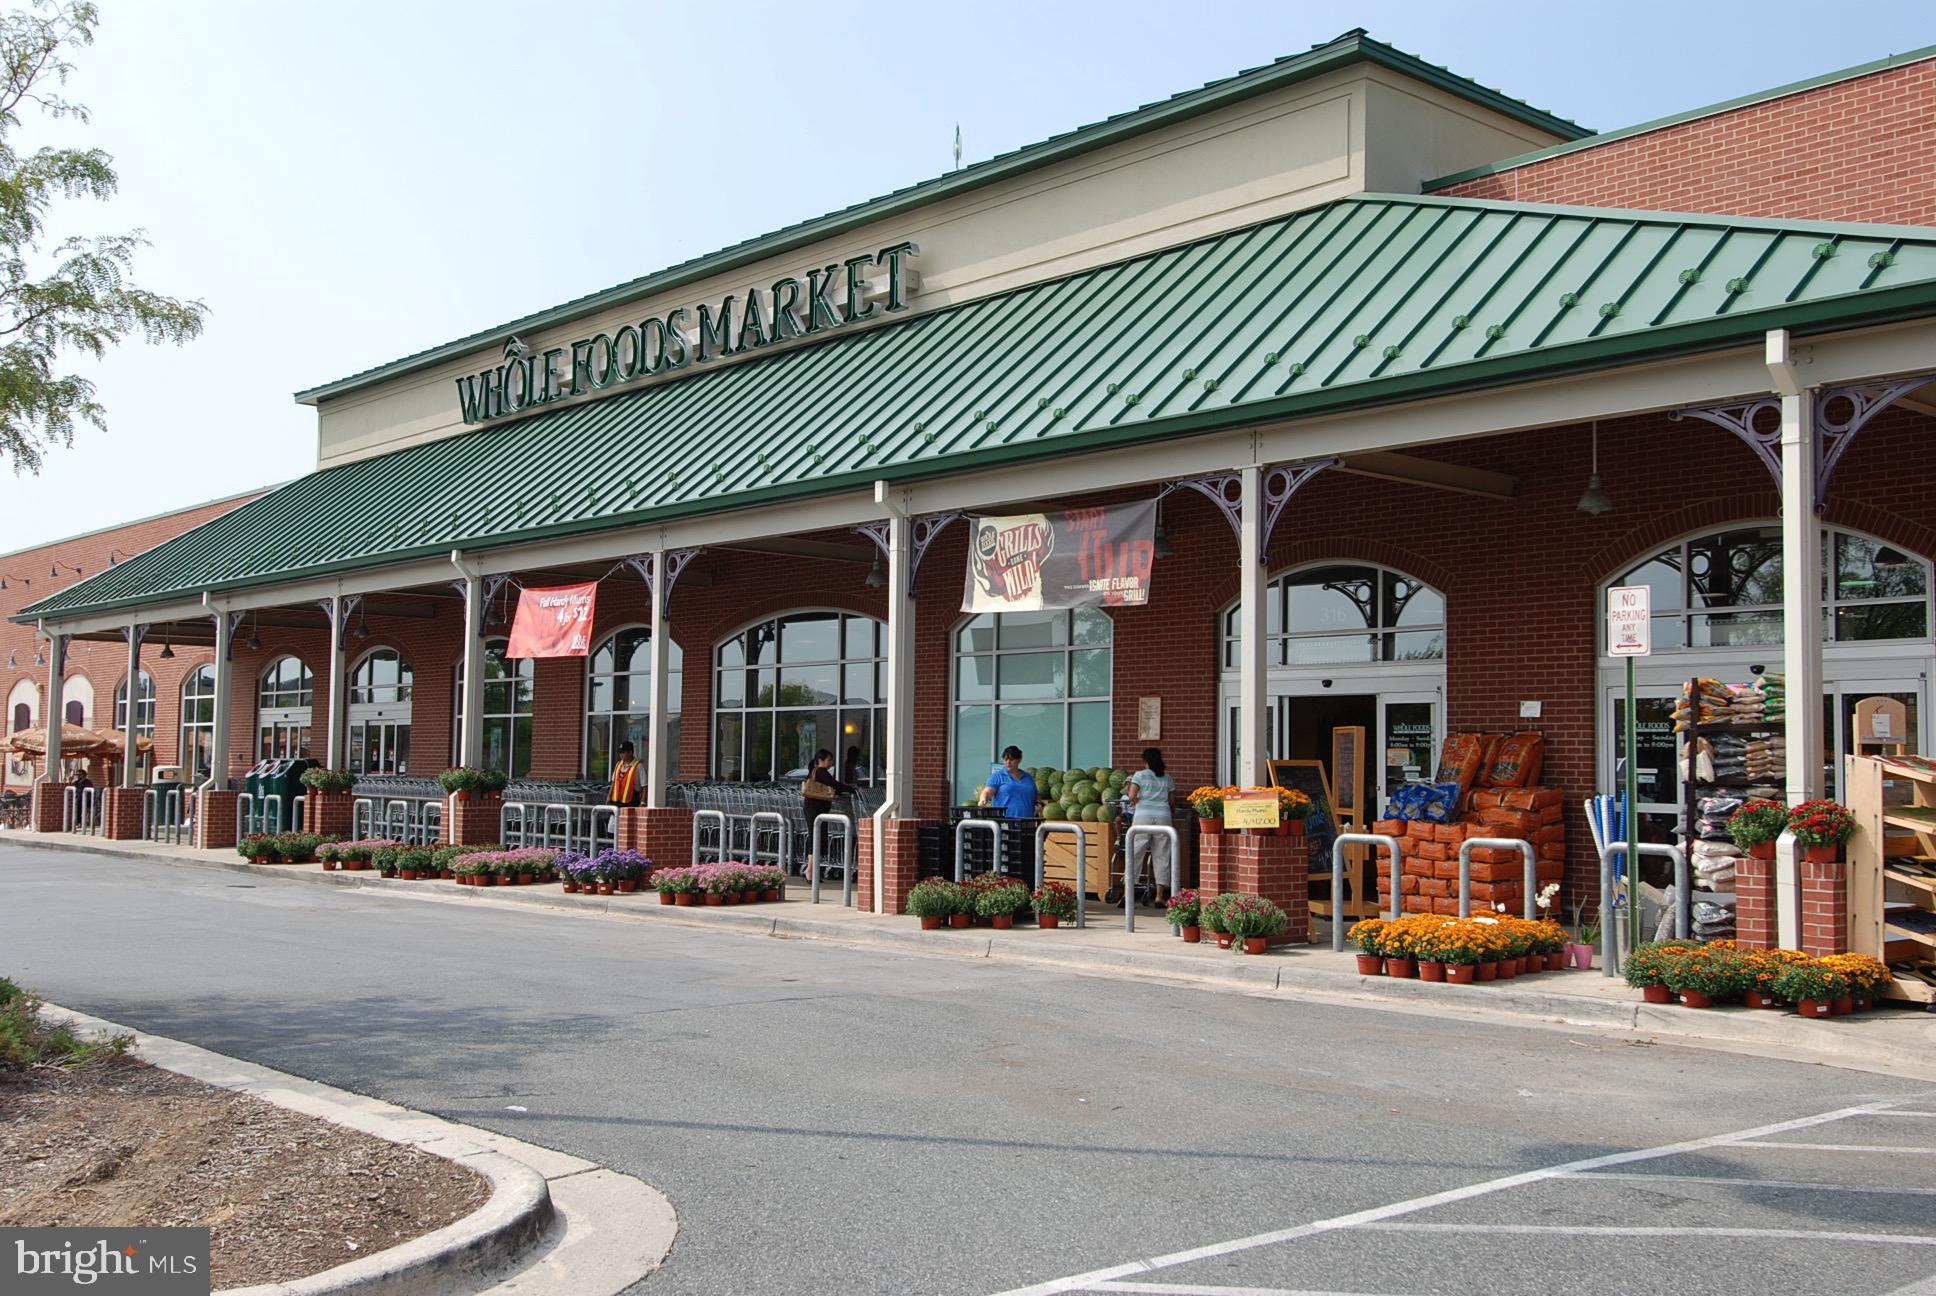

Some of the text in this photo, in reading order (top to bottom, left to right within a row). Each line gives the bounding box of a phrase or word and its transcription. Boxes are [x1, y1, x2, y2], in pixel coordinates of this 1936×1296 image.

[569, 307, 692, 397] FOODS
[696, 241, 921, 363] MARKET
[1065, 507, 1105, 533] START
[998, 525, 1042, 567] GRILLS
[1078, 529, 1108, 581] IT
[1002, 552, 1040, 597] WILD!
[1123, 588, 1145, 602] GRILL!
[1622, 594, 1636, 606] NO
[557, 608, 564, 622] 4
[1319, 606, 1347, 623] 316
[1612, 609, 1646, 621] PARKING
[1622, 624, 1635, 632] ANY
[1622, 633, 1637, 642] TIME
